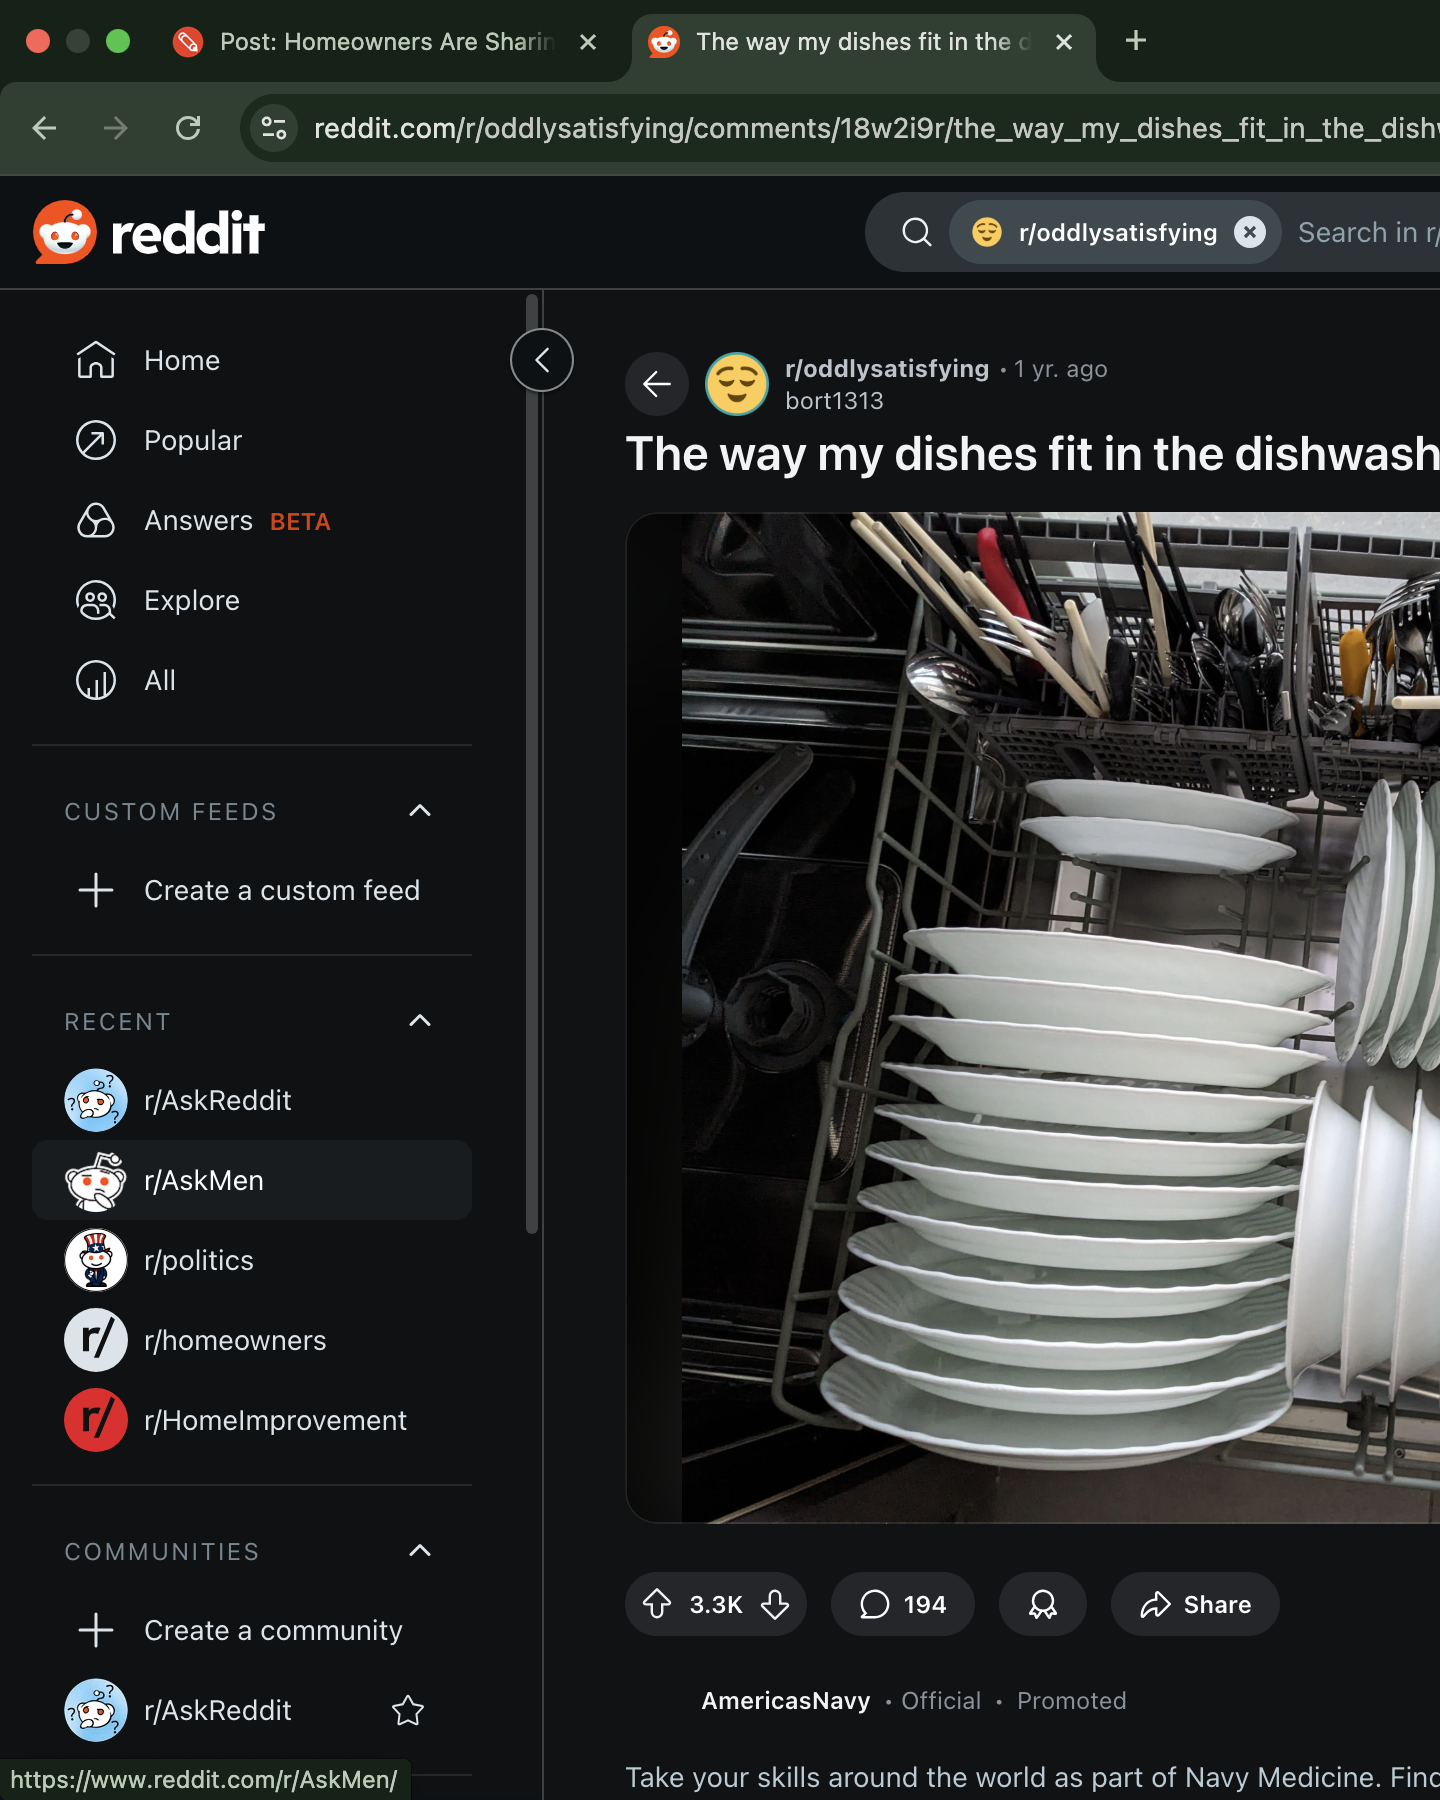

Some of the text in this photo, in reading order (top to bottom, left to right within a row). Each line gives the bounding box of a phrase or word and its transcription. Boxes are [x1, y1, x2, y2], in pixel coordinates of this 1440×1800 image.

[221, 31, 277, 52] Post:
[285, 31, 433, 52] Homeowners
[439, 31, 478, 52] Are
[696, 31, 739, 52] The
[745, 36, 791, 56] way
[798, 36, 832, 56] my
[838, 31, 912, 52] dishes
[917, 31, 942, 51] fit
[948, 31, 968, 51] in
[974, 31, 1012, 51] the
[112, 209, 266, 255] reddit
[1019, 221, 1217, 247] r/oddlysatisfying
[1298, 220, 1387, 244] Search
[1396, 220, 1418, 243] in
[145, 349, 221, 372] Home
[785, 357, 1108, 383] r/oddlysatisfying 1 yr. ago
[786, 390, 884, 410] bort1313
[145, 428, 243, 456] Popular
[625, 435, 708, 472] The
[719, 443, 808, 480] way
[819, 443, 885, 480] my
[895, 434, 1038, 472] dishes
[1048, 434, 1093, 472] fit
[1105, 434, 1142, 471] in
[1153, 435, 1224, 472] the
[144, 509, 332, 532] Answers BETA
[145, 588, 240, 616] Explore
[144, 668, 175, 691] All
[64, 801, 276, 822] CUSTOM FEEDS
[144, 878, 420, 902] Create a custom feed
[65, 1011, 171, 1032] RECENT
[145, 1088, 292, 1116] r/AskReddit
[145, 1168, 264, 1196] r/AskMen
[145, 1248, 254, 1276] r/politics
[145, 1328, 327, 1356] r/homeowners
[145, 1408, 408, 1436] r/HomeImprovement
[64, 1541, 259, 1562] COMMUNITIES
[689, 1595, 744, 1615] 3.3K
[904, 1594, 947, 1615] 194
[1184, 1594, 1252, 1615] Share
[144, 1618, 404, 1646] Create a community
[145, 1698, 292, 1726] r/AskReddit
[701, 1689, 1127, 1715] AmericasNavy Official Promoted
[11, 1769, 398, 1794] https://www.reddit.com/r/AskMen/
[625, 1765, 685, 1788] Take
[692, 1771, 750, 1793] your
[757, 1765, 820, 1788] skills
[828, 1765, 918, 1789] around
[926, 1765, 968, 1788] the
[975, 1765, 1046, 1789] world
[1054, 1771, 1083, 1788] as
[1092, 1767, 1144, 1793] part
[1151, 1765, 1178, 1789] of
[1186, 1766, 1250, 1793] Navy
[1258, 1765, 1381, 1789] Medicine.
